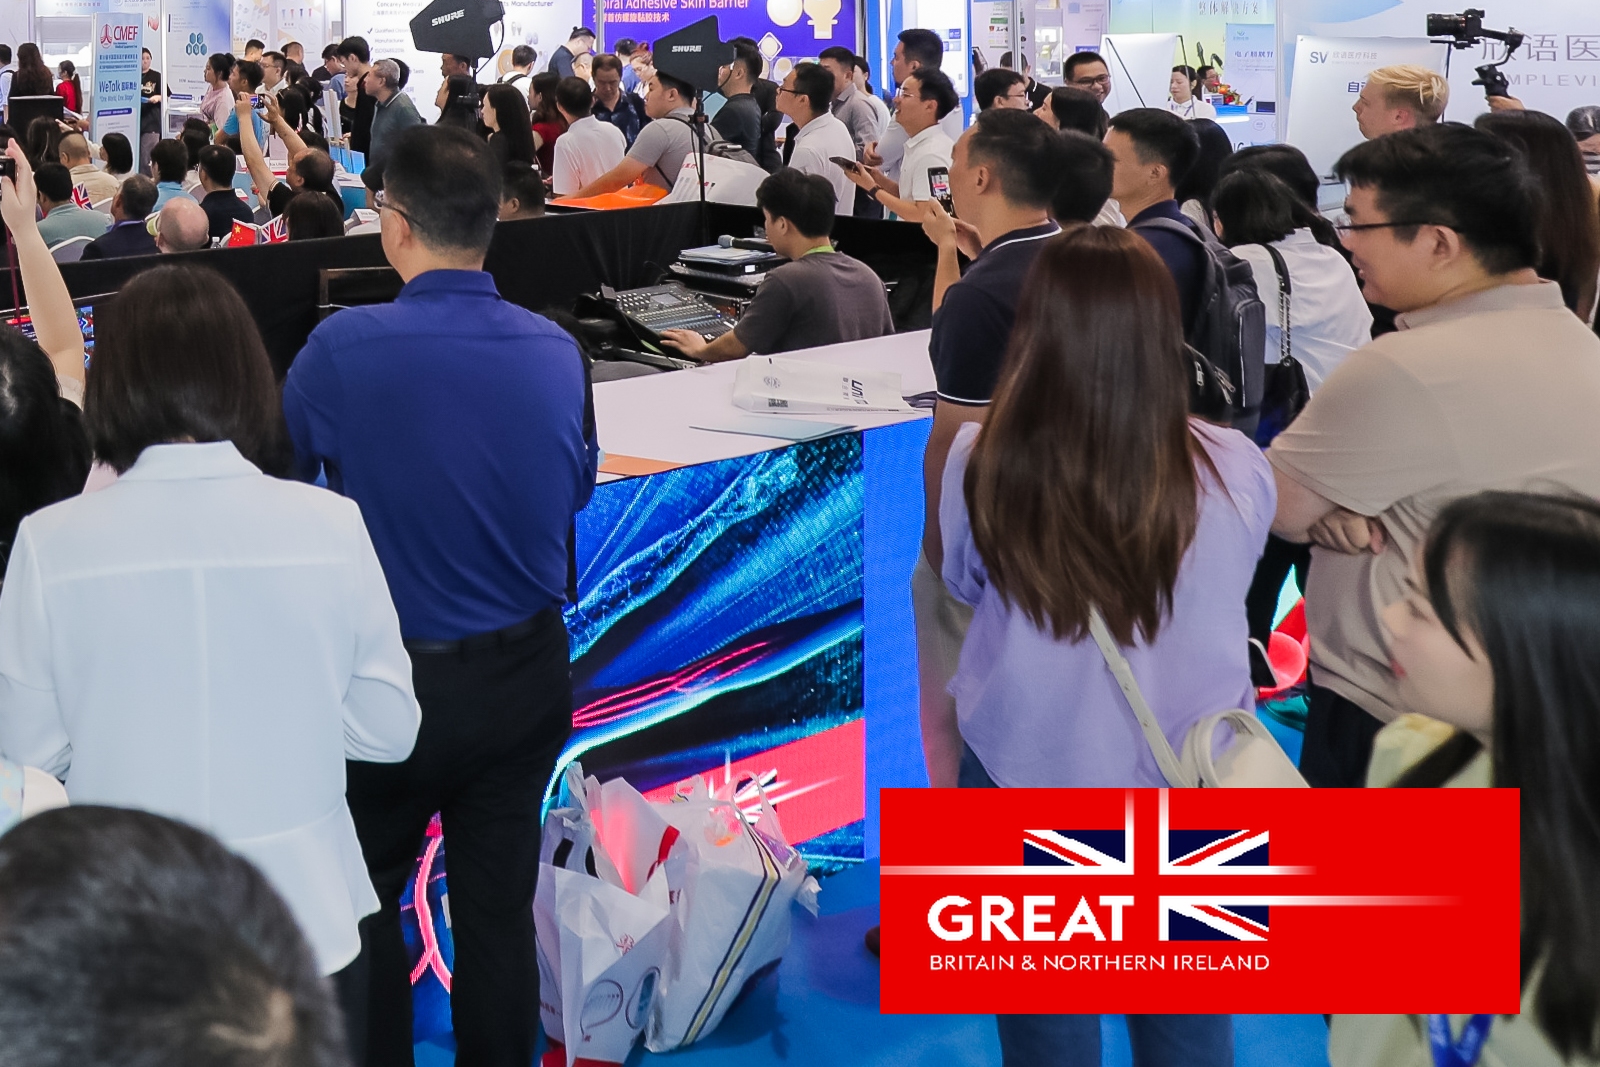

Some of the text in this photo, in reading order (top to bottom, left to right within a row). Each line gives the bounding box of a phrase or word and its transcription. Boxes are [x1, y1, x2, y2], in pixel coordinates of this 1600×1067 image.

[511, 0, 554, 7] Manufacturer
[431, 8, 465, 27] SHURE
[113, 25, 139, 42] CMEF
[671, 45, 702, 53] SHURE
[1309, 50, 1328, 64] SV
[99, 79, 121, 93] WeTalk
